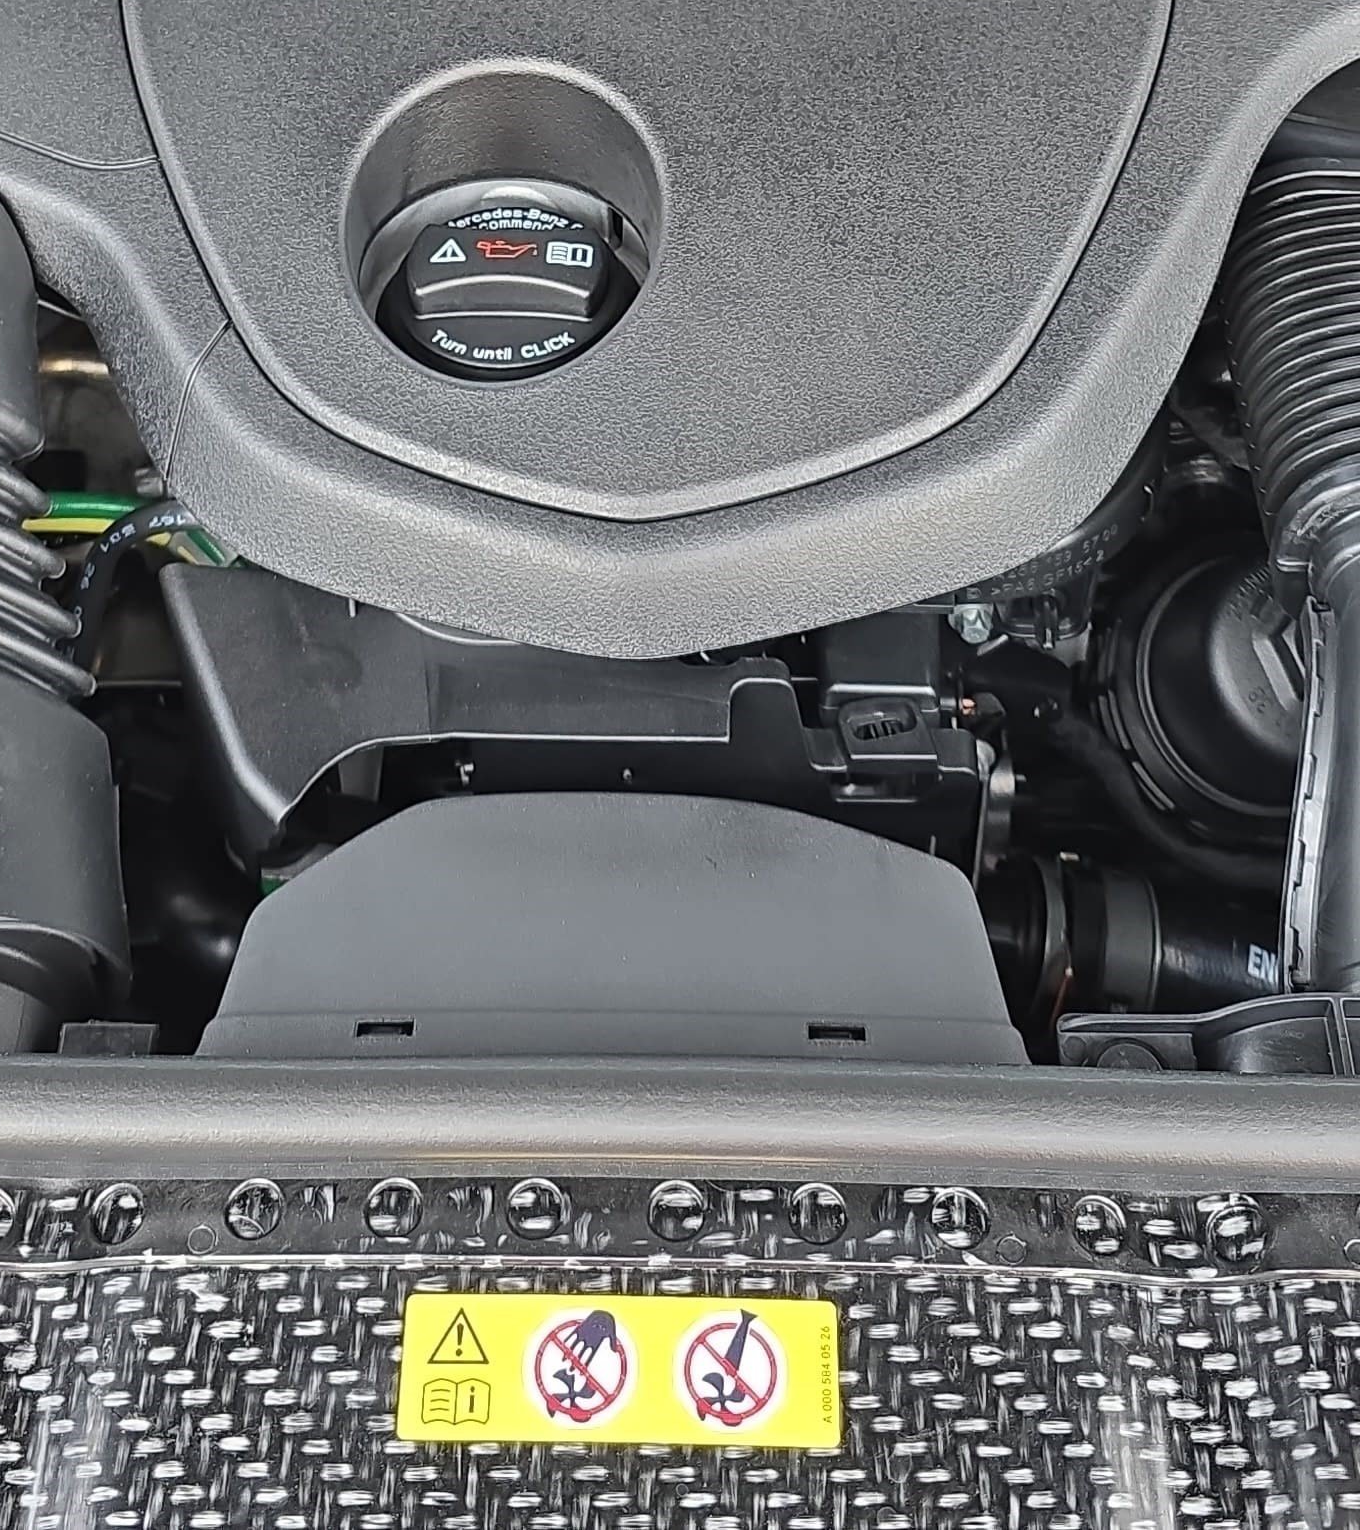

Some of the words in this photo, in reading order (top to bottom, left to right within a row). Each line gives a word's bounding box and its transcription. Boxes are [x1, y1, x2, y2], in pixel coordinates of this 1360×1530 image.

[432, 329, 468, 356] Turn
[472, 346, 513, 361] until
[520, 331, 576, 359] CLICK
[1247, 943, 1279, 983] EN
[820, 1324, 831, 1341] 26
[820, 1343, 831, 1360] 05
[821, 1362, 832, 1385] 584
[822, 1387, 833, 1413] 000
[823, 1415, 833, 1425] A
